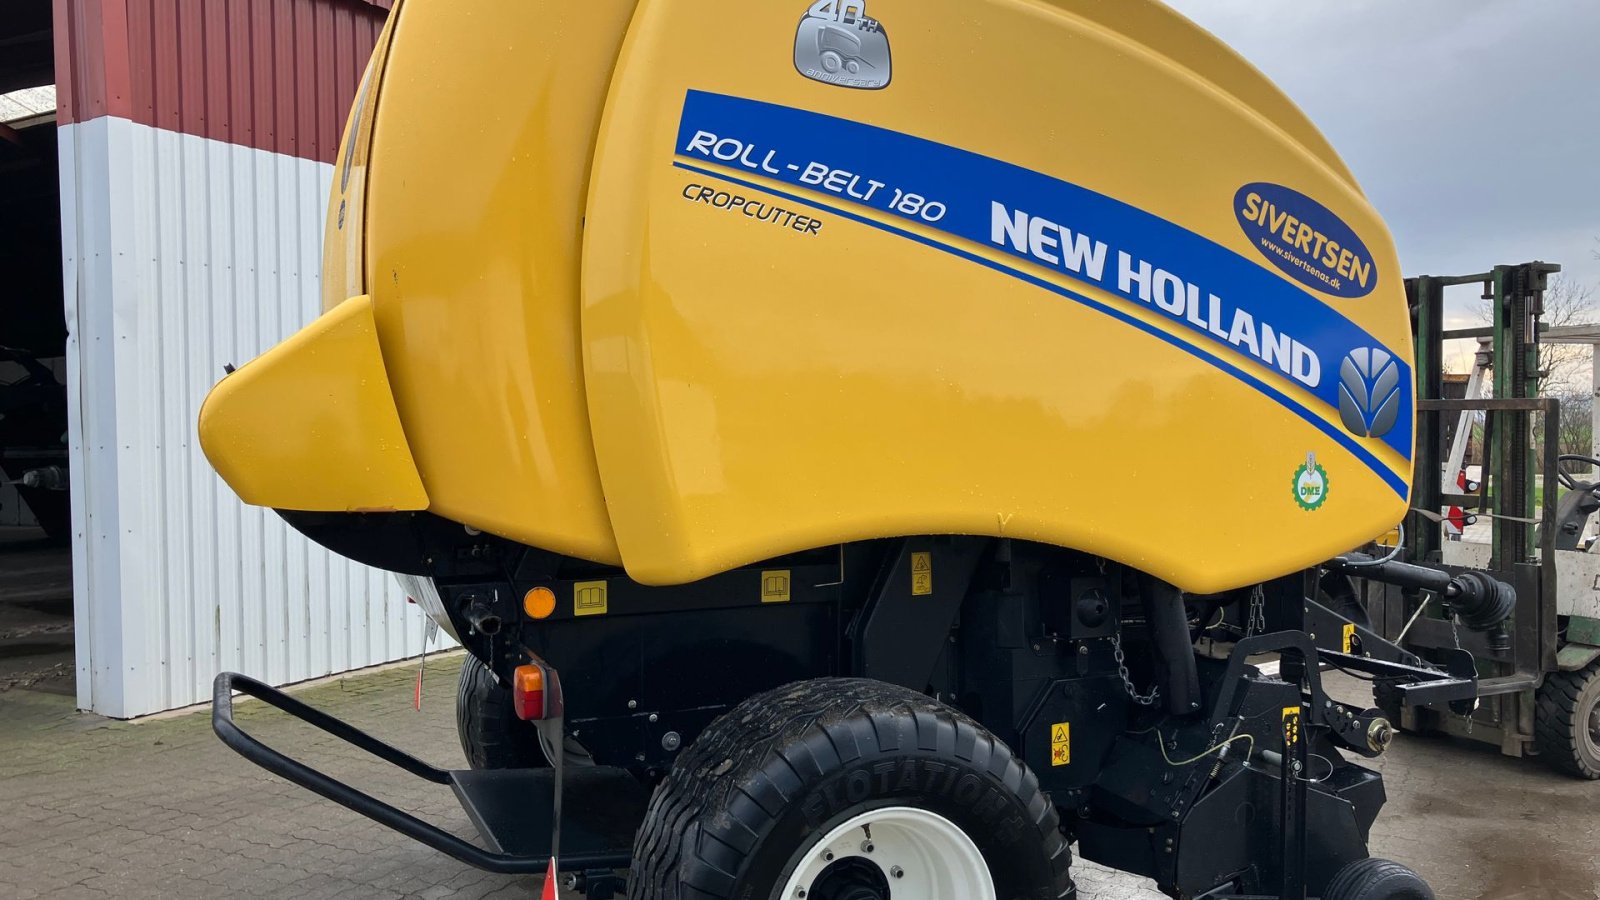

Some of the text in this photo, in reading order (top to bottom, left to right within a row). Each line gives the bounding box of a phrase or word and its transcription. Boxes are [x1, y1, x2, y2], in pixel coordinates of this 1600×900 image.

[806, 68, 882, 87] anniversary
[682, 183, 823, 235] CROPCUTTER
[888, 188, 947, 222] 180
[1242, 192, 1370, 288] SIVERTSEN
[1261, 237, 1341, 290] www.sivertsenas.dk
[991, 200, 1321, 388] NEW HOLLAND
